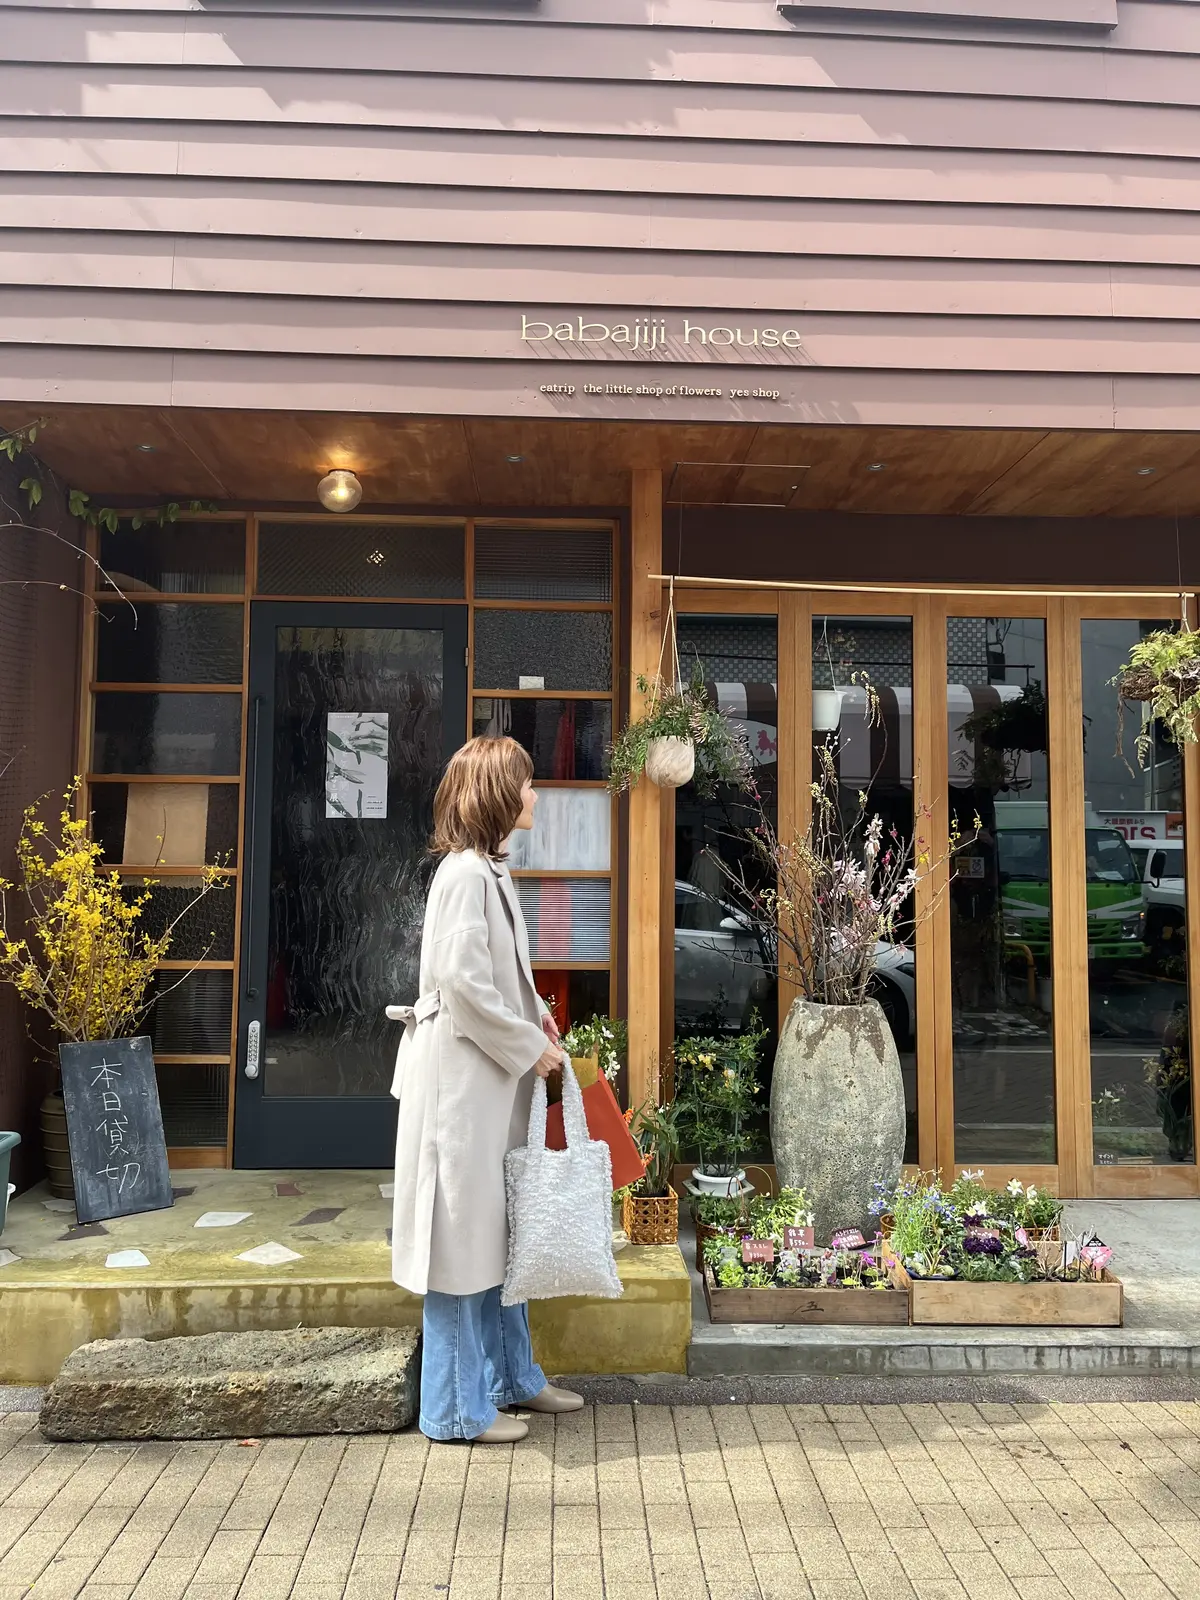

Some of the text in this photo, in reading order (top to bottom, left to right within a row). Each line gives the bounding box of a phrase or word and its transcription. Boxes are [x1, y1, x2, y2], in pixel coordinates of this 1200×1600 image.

[520, 314, 801, 351] babajiji house
[540, 383, 780, 400] eatrip the little shop of flowers yes shop
[90, 1058, 141, 1193] 本日貸切
